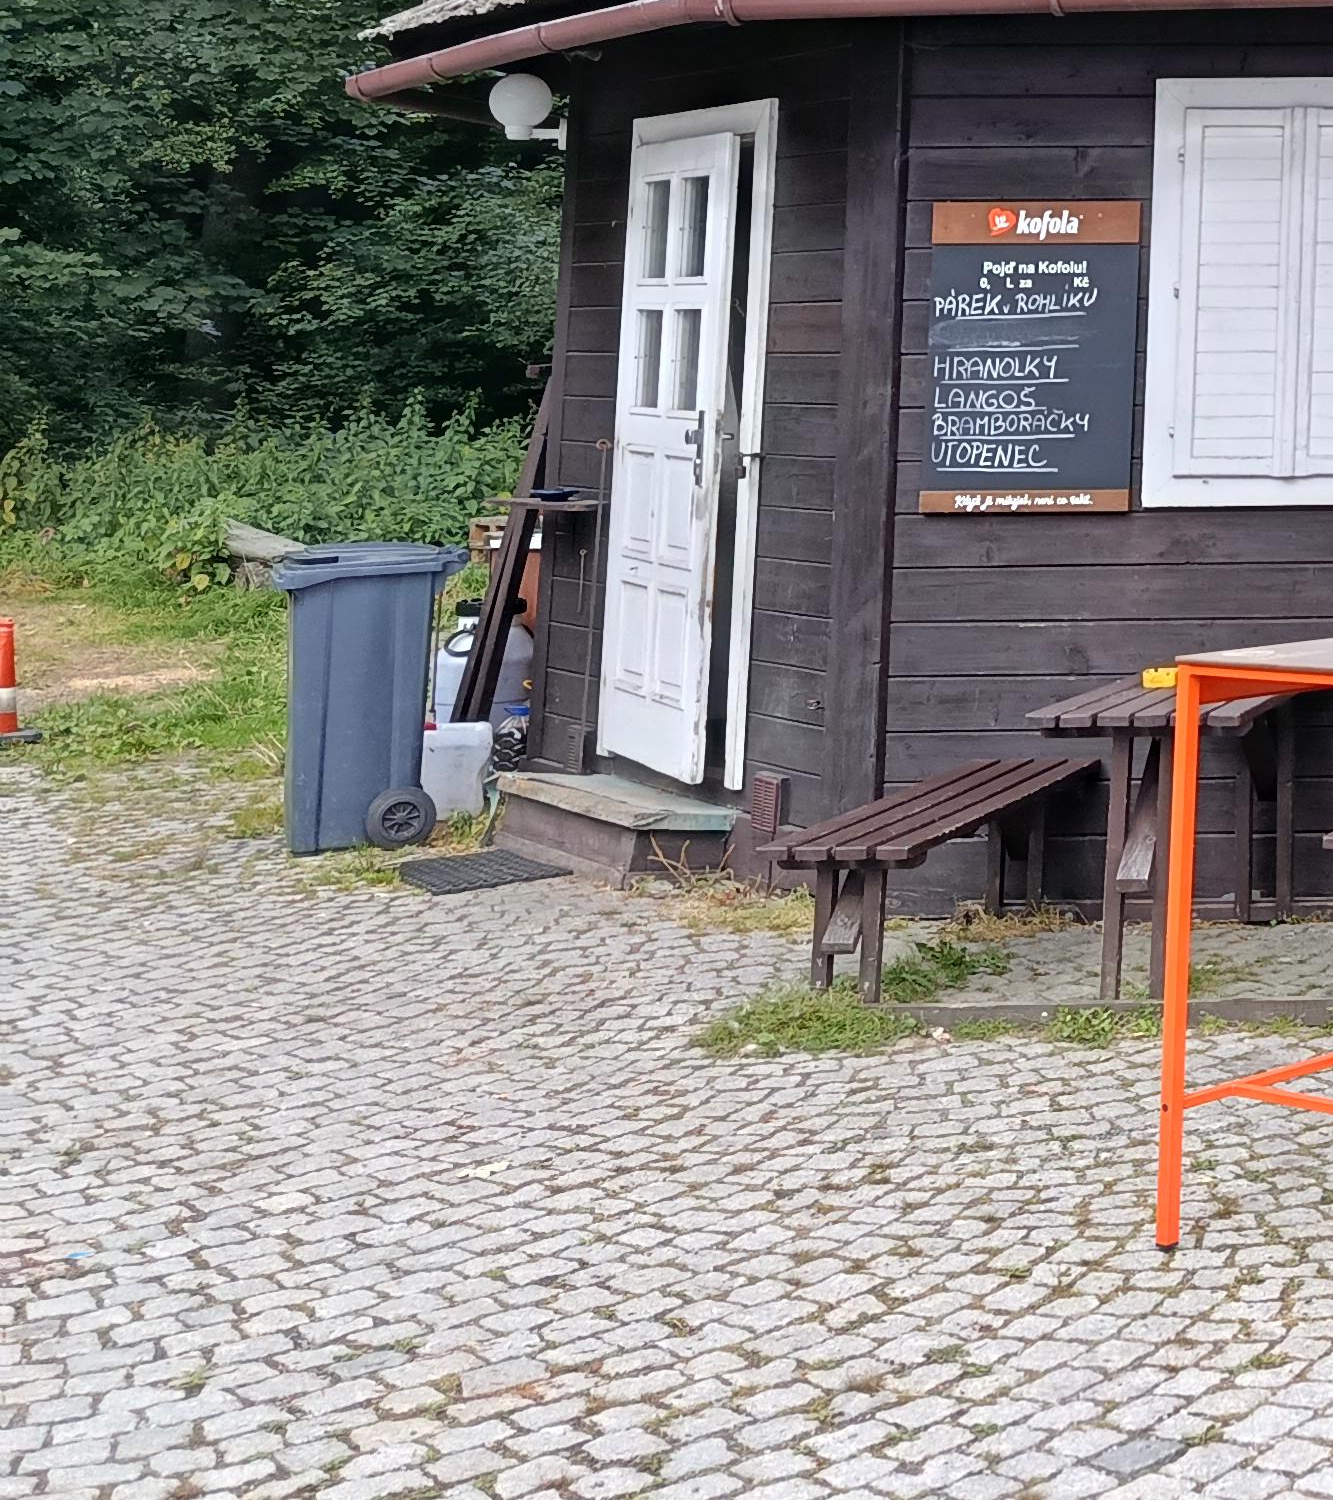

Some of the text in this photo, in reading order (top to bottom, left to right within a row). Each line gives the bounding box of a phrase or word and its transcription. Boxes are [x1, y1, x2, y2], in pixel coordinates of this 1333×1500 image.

[1016, 209, 1079, 240] kofola
[983, 261, 1087, 277] Pojď na Kofolu!
[1019, 279, 1033, 289] za
[1073, 276, 1090, 288] Kč
[934, 288, 1002, 317] PÁREK
[1015, 284, 1098, 314] ROHLÍKU
[933, 355, 1058, 380] HRANOLKY
[934, 387, 1036, 410] LANGOŠ
[932, 408, 1090, 436] BRAMBORÁČKY
[931, 442, 1048, 468] UTOPENEC
